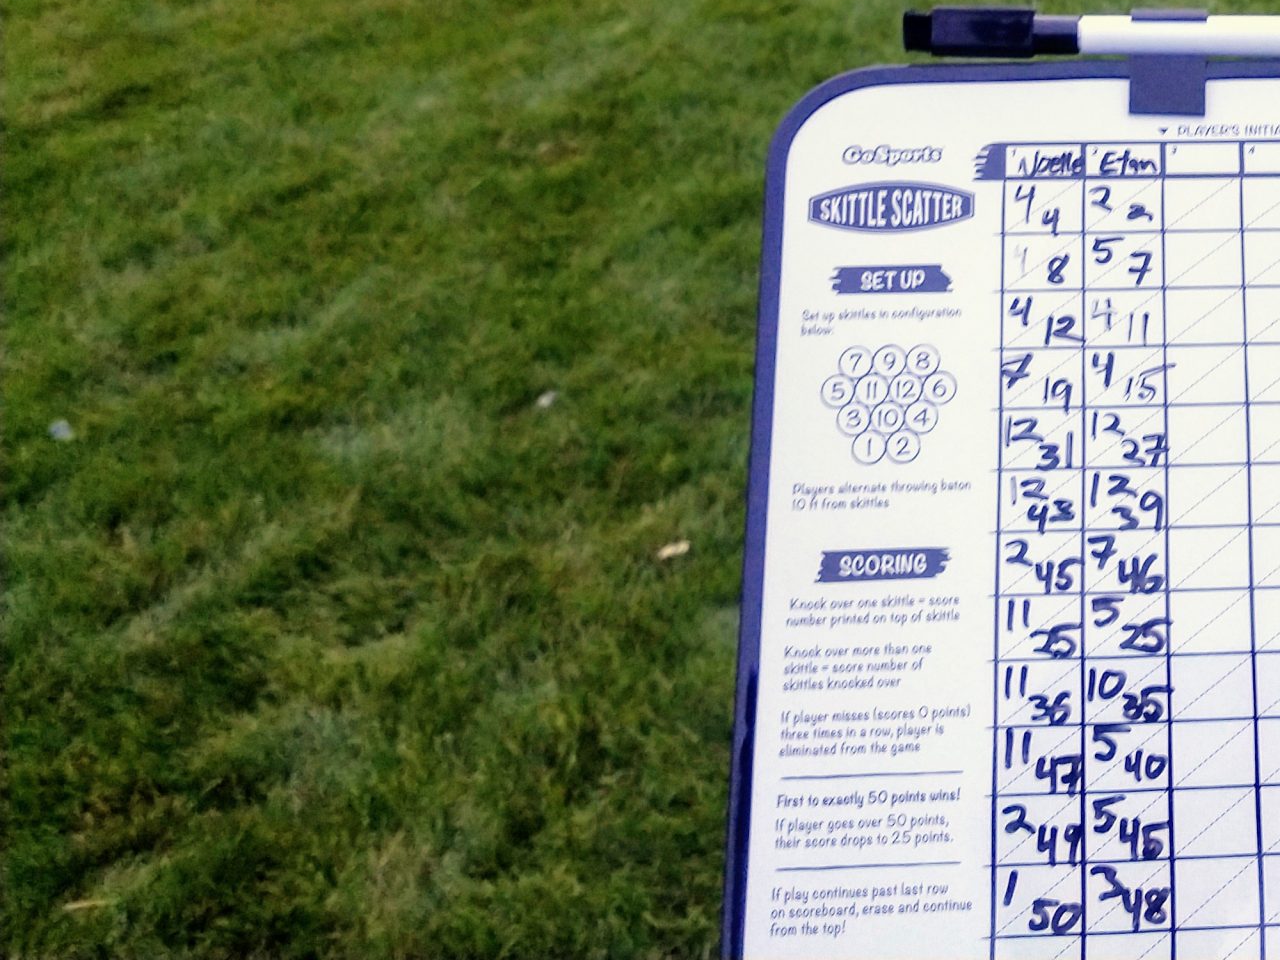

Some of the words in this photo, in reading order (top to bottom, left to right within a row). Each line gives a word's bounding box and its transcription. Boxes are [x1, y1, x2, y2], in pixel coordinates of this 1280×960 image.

[842, 144, 943, 166] GoSports
[820, 189, 888, 227] SKITTLE
[891, 189, 963, 227] SCATTER
[1014, 184, 1036, 224] 4
[1089, 185, 1113, 212] 2
[1041, 207, 1060, 237] 4
[1092, 237, 1125, 264] 5
[861, 271, 898, 291] SET
[900, 269, 925, 290] UP
[1047, 253, 1070, 284] 8
[1128, 251, 1152, 287] 7
[802, 309, 820, 321] Set
[822, 312, 835, 323] up
[838, 308, 876, 320] skittles
[879, 309, 889, 318] in
[891, 307, 962, 320] configuration
[1009, 296, 1033, 326] 4
[1091, 297, 1118, 331] 4
[1044, 315, 1086, 346] 12
[1128, 312, 1150, 346] 11
[850, 353, 863, 373] 7
[883, 352, 896, 370] 9
[916, 351, 930, 370] 8
[1091, 352, 1115, 388] 4
[832, 382, 846, 401] 5
[866, 381, 878, 399] 11
[895, 380, 915, 398] 12
[932, 379, 947, 397] 6
[1043, 376, 1073, 415] 19
[1125, 363, 1176, 402] 15
[846, 409, 861, 428] 3
[878, 409, 899, 427] 10
[913, 408, 930, 426] 4
[1005, 415, 1044, 447] 12
[1091, 410, 1125, 441] 12
[866, 438, 871, 457] 1
[896, 436, 910, 455] 2
[1035, 431, 1073, 470] 31
[1121, 433, 1170, 467] 27
[792, 482, 834, 498] Players
[838, 481, 887, 494] alternate
[891, 479, 937, 494] throwing
[941, 479, 971, 490] baton
[809, 496, 817, 510] ft
[821, 498, 846, 510] from
[850, 496, 889, 508] skittles
[1011, 476, 1049, 505] 12
[1090, 471, 1137, 507] 12
[1111, 491, 1164, 531] 39
[838, 553, 927, 577] SCORING
[1005, 539, 1033, 567] 2
[1087, 535, 1118, 570] 7
[1035, 557, 1085, 594] 45
[1118, 553, 1165, 594] 46
[789, 597, 827, 611] Knock
[830, 599, 854, 609] over
[858, 598, 878, 608] one
[881, 595, 914, 608] skittle
[928, 595, 960, 606] score
[1008, 599, 1031, 631] 11
[1092, 595, 1125, 627] 5
[785, 614, 827, 628] number
[830, 612, 870, 629] printed
[873, 614, 887, 623] on
[890, 612, 908, 626] top
[911, 610, 923, 621] of
[926, 610, 960, 621] skittle
[1120, 617, 1173, 653] 25
[784, 644, 822, 659] Knock
[825, 647, 849, 658] over
[853, 646, 880, 656] more
[884, 643, 909, 655] than
[912, 643, 932, 654] one
[1030, 623, 1084, 659] 25
[784, 661, 818, 675] skittle
[832, 663, 864, 673] score
[867, 660, 908, 671] number
[912, 657, 924, 671] of
[783, 677, 824, 691] skittles
[827, 676, 874, 689] knocked
[877, 677, 901, 688] over
[1004, 665, 1028, 700] 11
[1087, 667, 1127, 702] 10
[780, 711, 790, 724] If
[793, 711, 829, 726] player
[832, 711, 870, 722] misses
[873, 706, 915, 721] (scores
[932, 704, 971, 718] points)
[1028, 691, 1072, 725] 36
[780, 728, 809, 740] three
[812, 727, 843, 738] times
[846, 726, 856, 737] in
[859, 728, 866, 737] a
[870, 727, 894, 738] row,
[896, 723, 932, 738] player
[935, 723, 945, 733] is
[1093, 725, 1132, 762] 5
[779, 742, 837, 757] eliminated
[839, 742, 867, 754] from
[870, 742, 887, 753] the
[891, 742, 921, 756] game
[1004, 727, 1032, 769] 11
[1124, 749, 1168, 780] 40
[776, 794, 804, 808] First
[808, 794, 819, 806] to
[822, 791, 865, 808] exactly
[868, 790, 888, 804] 50
[891, 790, 926, 806] points
[929, 788, 961, 802] wins!
[775, 818, 784, 831] If
[788, 817, 824, 833] player
[827, 818, 854, 833] goes
[858, 816, 883, 828] over
[887, 814, 907, 827] 50
[910, 814, 949, 829] points,
[1002, 803, 1036, 834] 2
[1092, 794, 1126, 834] 5
[775, 835, 801, 849] their
[805, 836, 837, 847] score
[840, 834, 873, 850] drops
[877, 833, 888, 844] to
[891, 831, 911, 844] 25
[914, 830, 954, 847] points.
[1037, 823, 1083, 867] 49
[1119, 817, 1169, 861] 45
[771, 887, 781, 901] If
[784, 885, 809, 904] play
[812, 884, 868, 899] continues
[872, 883, 898, 900] past
[901, 882, 924, 895] last
[927, 883, 948, 894] row
[1003, 869, 1018, 906] 1
[1090, 865, 1124, 901] 3
[771, 906, 785, 920] on
[789, 902, 860, 918] scoreboard,
[862, 904, 894, 915] erase
[898, 900, 919, 913] and
[923, 899, 972, 912] continue
[1028, 897, 1084, 936] 50
[1122, 887, 1172, 933] 48
[770, 922, 797, 936] from
[801, 921, 818, 935] the
[822, 920, 846, 938] top!
